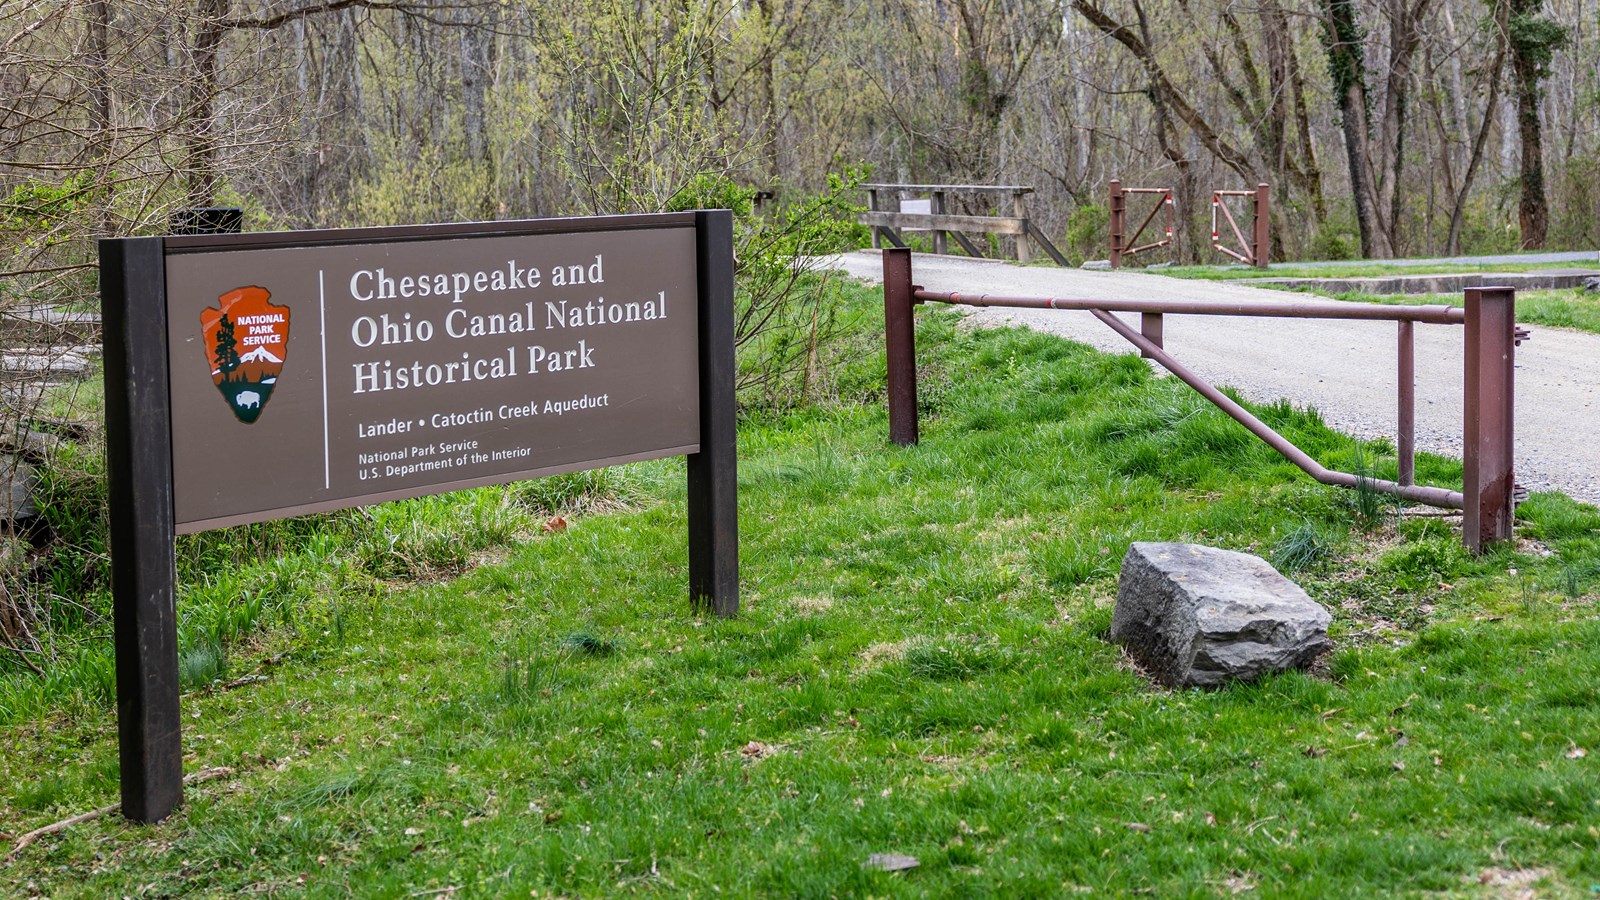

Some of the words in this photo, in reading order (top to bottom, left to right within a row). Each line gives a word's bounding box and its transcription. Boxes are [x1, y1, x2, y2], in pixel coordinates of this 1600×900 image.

[350, 260, 541, 303] Chesapeake
[552, 254, 604, 286] and
[237, 314, 285, 326] NATIONAL
[249, 325, 274, 335] PARK
[352, 313, 433, 347] Ohio
[446, 302, 535, 338] Canal
[545, 291, 667, 329] National
[243, 334, 281, 346] SERVICE
[353, 347, 517, 393] Historical
[528, 340, 595, 374] Park
[358, 418, 413, 438] Lander
[431, 407, 494, 429] Catoctin
[498, 400, 539, 420] Creek
[543, 393, 609, 416] Aqueduct
[358, 447, 408, 465] National
[411, 443, 436, 458] Park
[439, 440, 478, 454] Service
[359, 467, 382, 481] U.S.
[385, 457, 453, 478] Department
[455, 453, 468, 466] of
[470, 452, 489, 464] the
[491, 447, 531, 461] Interior
